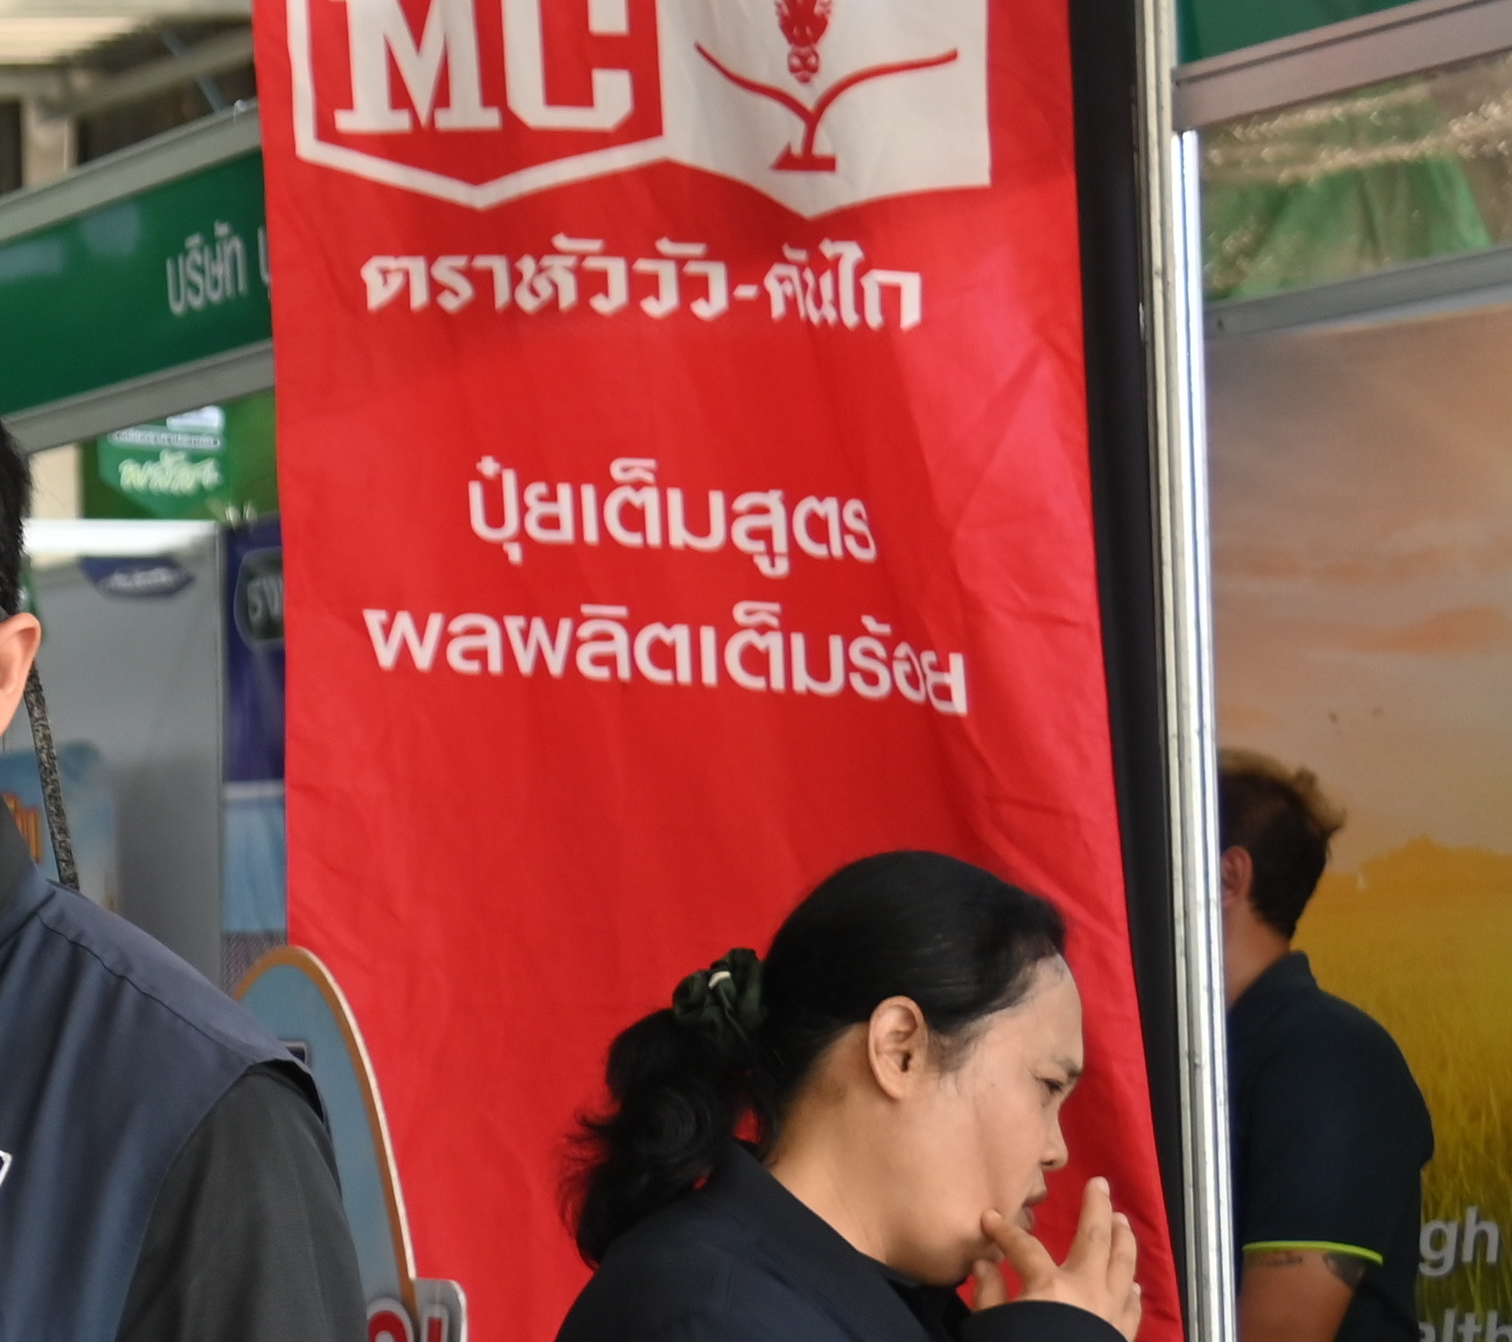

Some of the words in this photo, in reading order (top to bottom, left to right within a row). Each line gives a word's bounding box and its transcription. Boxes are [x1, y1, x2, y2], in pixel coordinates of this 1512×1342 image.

[167, 220, 247, 317] บริษัท
[362, 599, 969, 716] ผลผลิตเต็มร้อย
